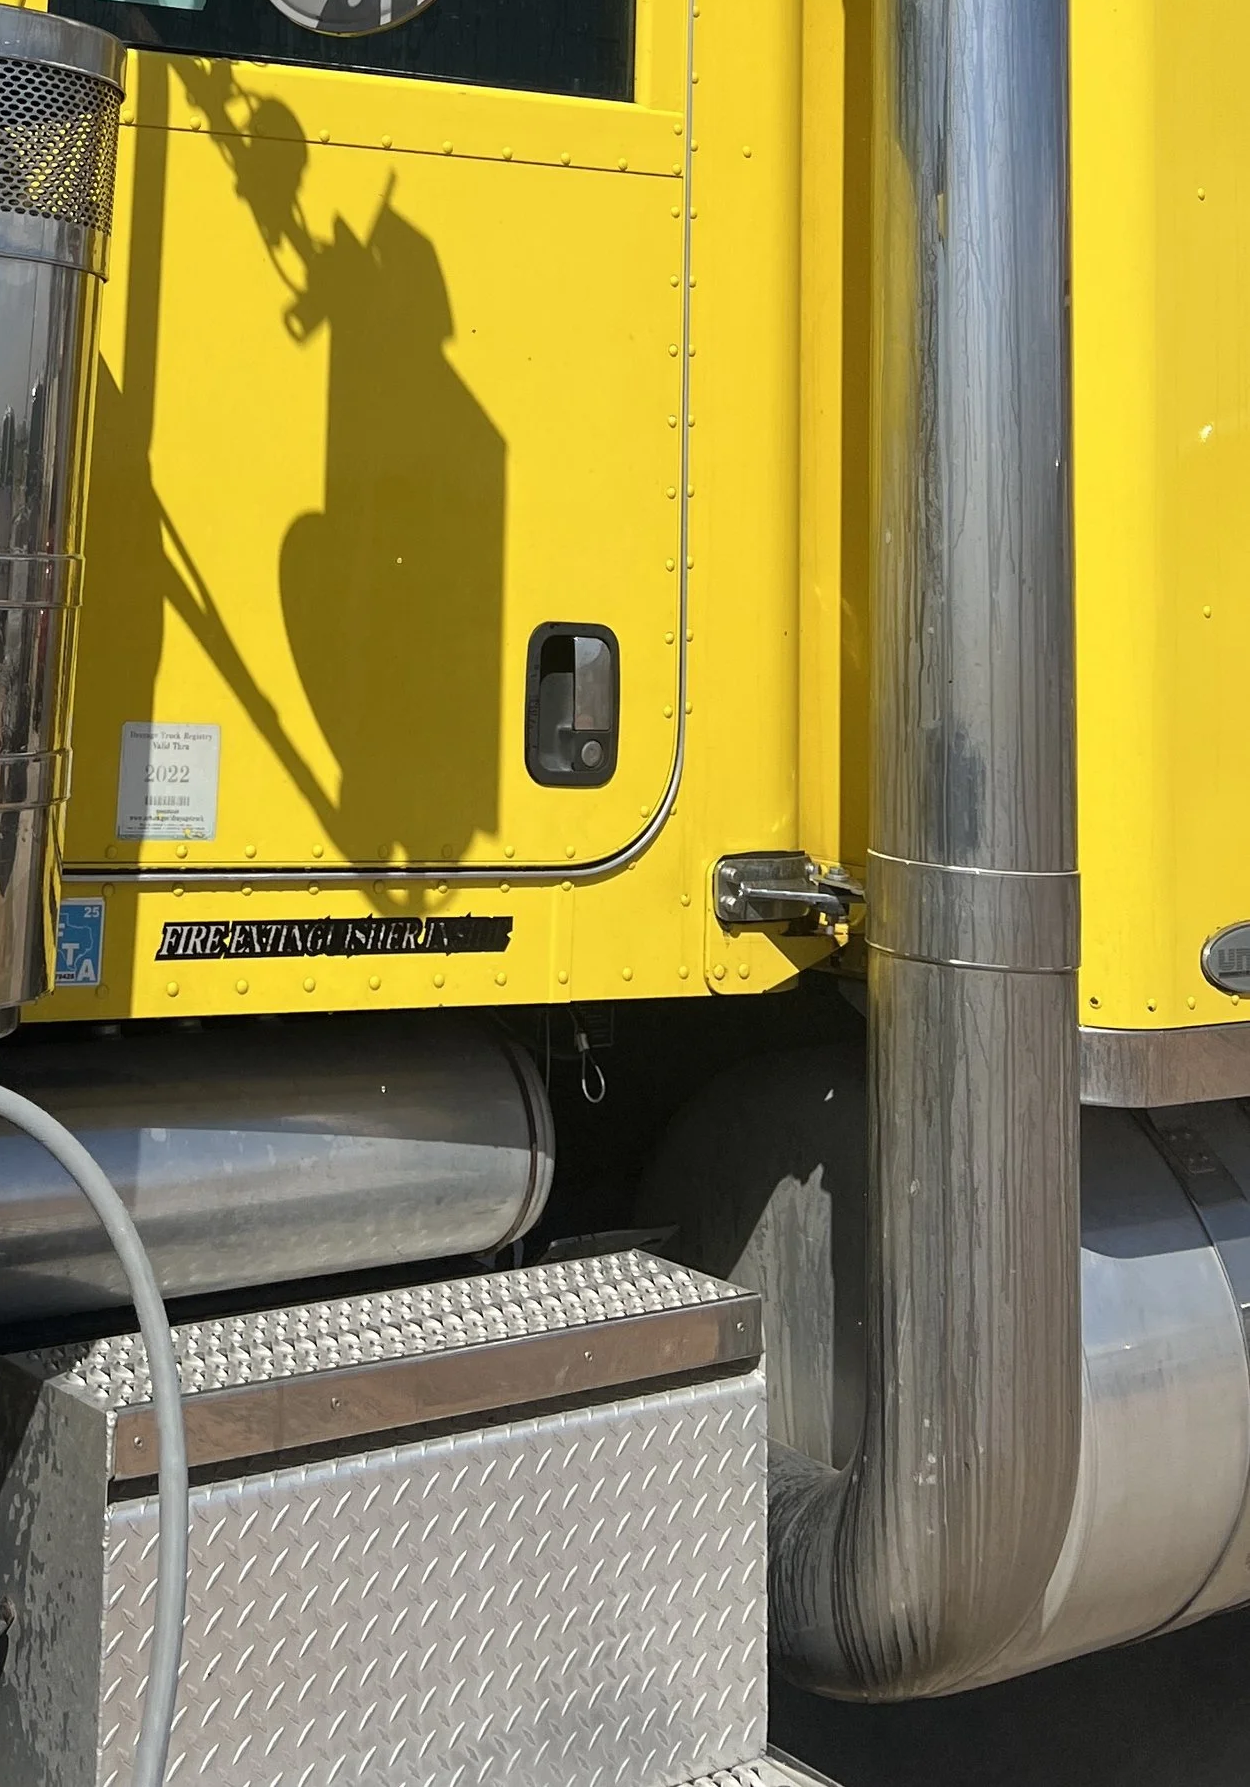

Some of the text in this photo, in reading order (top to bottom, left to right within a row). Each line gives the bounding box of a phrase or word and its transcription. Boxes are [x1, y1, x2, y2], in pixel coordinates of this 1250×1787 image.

[161, 731, 180, 739] Truck
[184, 732, 212, 742] Registry
[153, 741, 190, 750] Valid Thru
[144, 765, 190, 783] 2022
[83, 906, 100, 918] 25
[159, 925, 226, 955] FIRE
